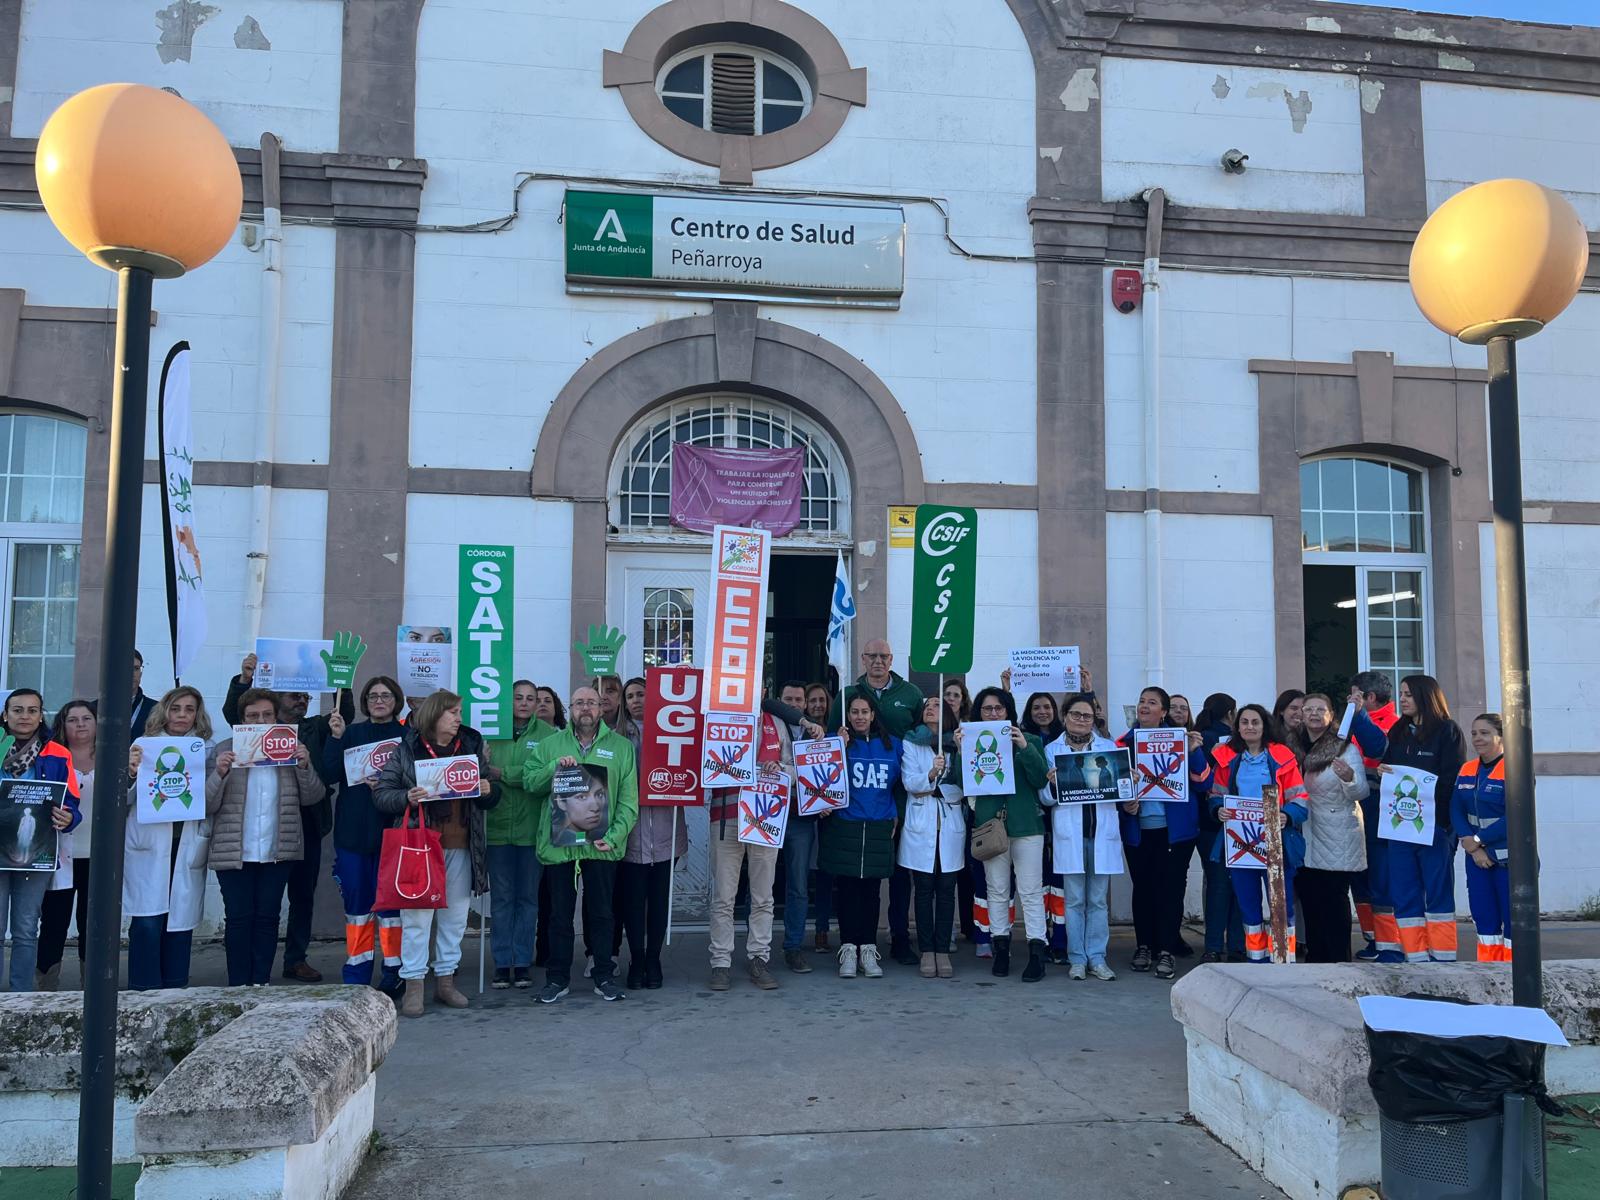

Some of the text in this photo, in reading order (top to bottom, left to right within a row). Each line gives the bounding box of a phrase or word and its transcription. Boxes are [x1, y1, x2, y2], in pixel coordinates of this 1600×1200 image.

[671, 216, 855, 245] Centro de Salud
[572, 242, 646, 254] Junta de Andalucía
[672, 248, 762, 272] Peñarroya
[716, 469, 750, 478] TRABAJAR
[762, 470, 796, 478] IGUALDAD
[716, 497, 755, 506] VIOLENCIAS
[930, 524, 970, 543] CSIF
[467, 548, 506, 558] CÓRDOBA
[930, 563, 956, 666] CSIF
[467, 560, 504, 736] SATSE
[718, 586, 752, 705] CCOO
[656, 674, 698, 766] UGT
[710, 726, 748, 740] STOP
[266, 738, 296, 750] STOP
[1146, 742, 1175, 752] STOP
[722, 744, 743, 764] NO
[805, 752, 832, 764] STOP
[704, 759, 751, 780] AGRESIONES
[1152, 752, 1181, 777] NO
[448, 769, 477, 781] STOP
[651, 772, 669, 781] UGT
[812, 762, 840, 790] NO
[751, 784, 779, 793] STOP
[755, 794, 782, 821] NO
[1235, 811, 1264, 821] STOP
